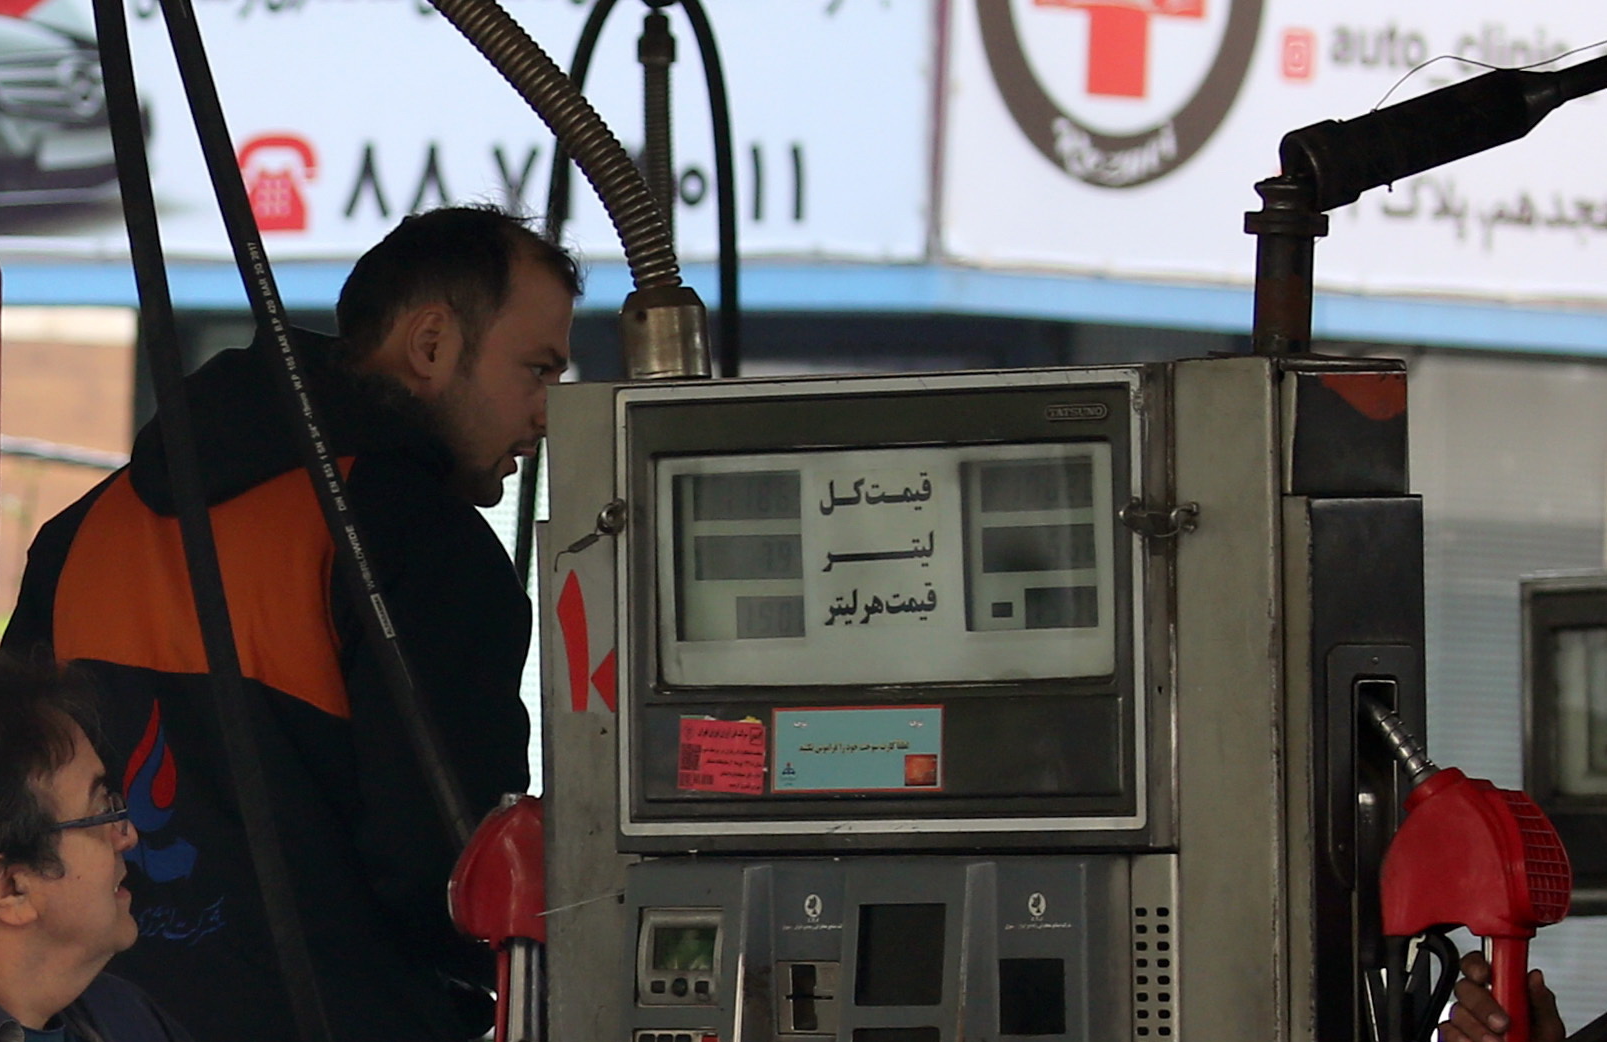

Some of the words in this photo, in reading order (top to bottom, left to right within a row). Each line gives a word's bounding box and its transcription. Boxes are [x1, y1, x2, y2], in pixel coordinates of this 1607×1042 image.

[819, 477, 866, 516] کل
[864, 471, 933, 512] قیمت
[820, 530, 935, 572] لیتر
[823, 588, 860, 626] لیتر
[884, 581, 938, 618] قیمت
